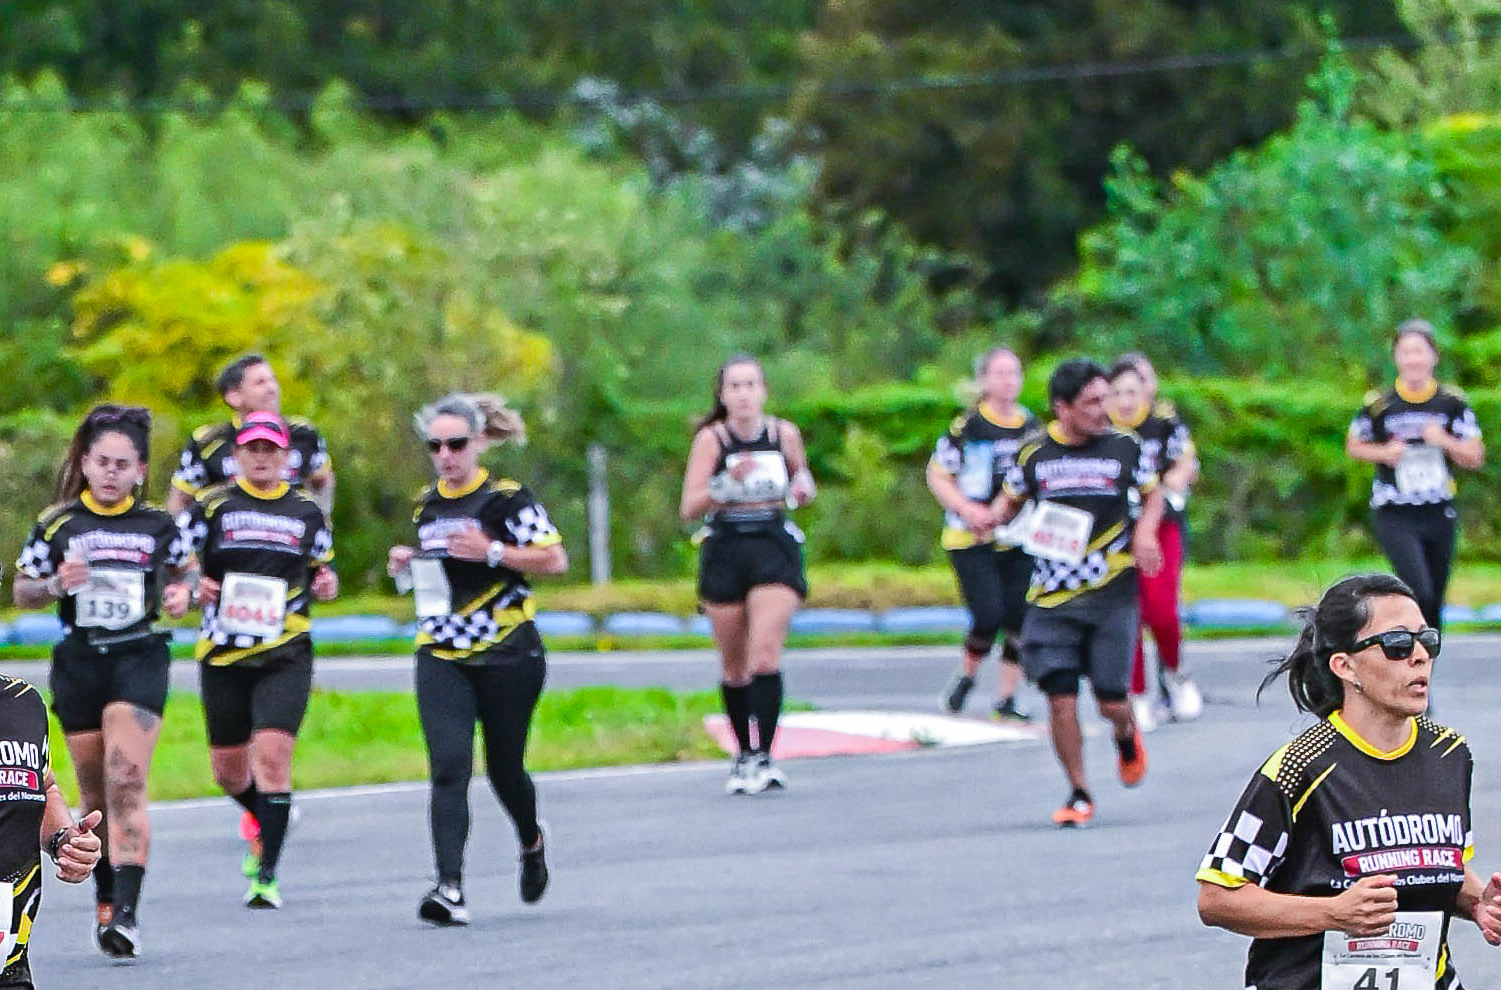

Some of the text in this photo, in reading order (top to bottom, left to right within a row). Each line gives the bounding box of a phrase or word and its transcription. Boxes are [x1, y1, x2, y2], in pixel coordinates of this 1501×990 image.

[88, 600, 130, 620] 139
[8, 791, 20, 801] del
[1331, 809, 1463, 855] AUTÓDROMO
[1358, 849, 1456, 873] RUNNING RACE
[1407, 874, 1436, 885] Clubes
[1437, 873, 1449, 883] del
